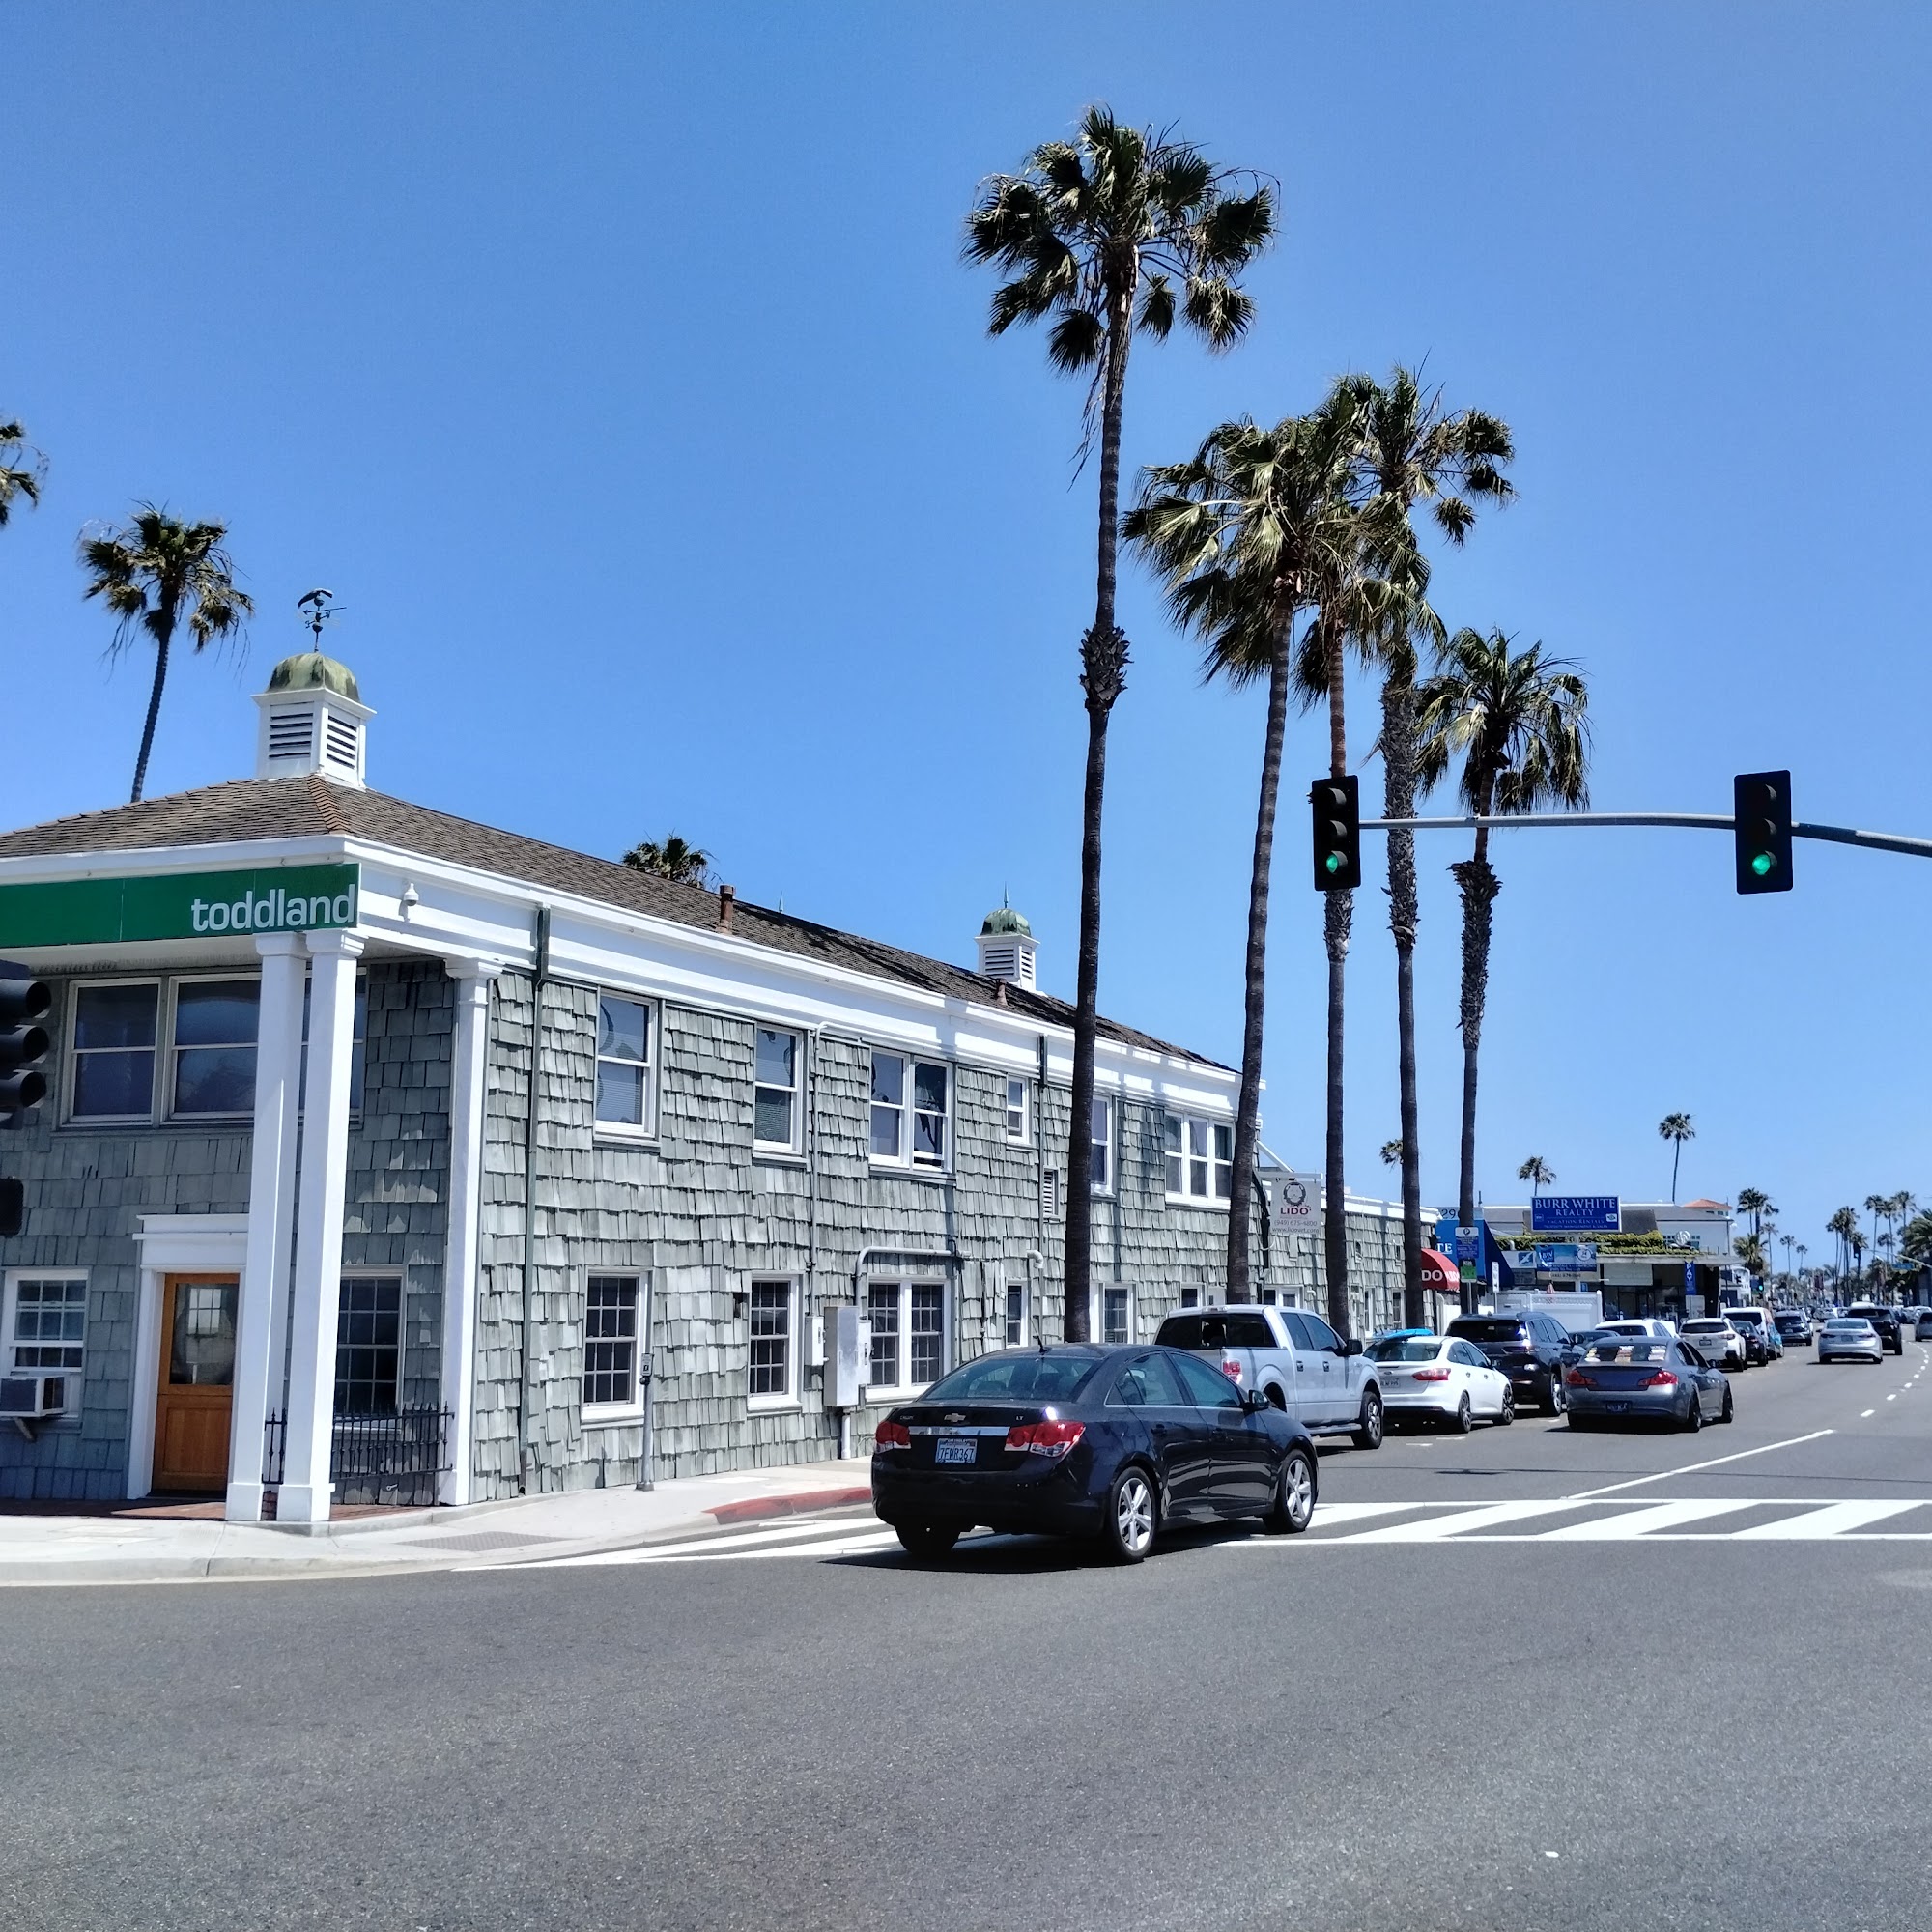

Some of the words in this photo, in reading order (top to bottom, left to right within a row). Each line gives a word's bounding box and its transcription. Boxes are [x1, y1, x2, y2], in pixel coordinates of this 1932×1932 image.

[191, 883, 355, 932] toddland
[1535, 1198, 1570, 1208] BURR
[1572, 1198, 1616, 1208] WHITE
[1280, 1207, 1309, 1215] LIDO
[1441, 1208, 1460, 1220] 29
